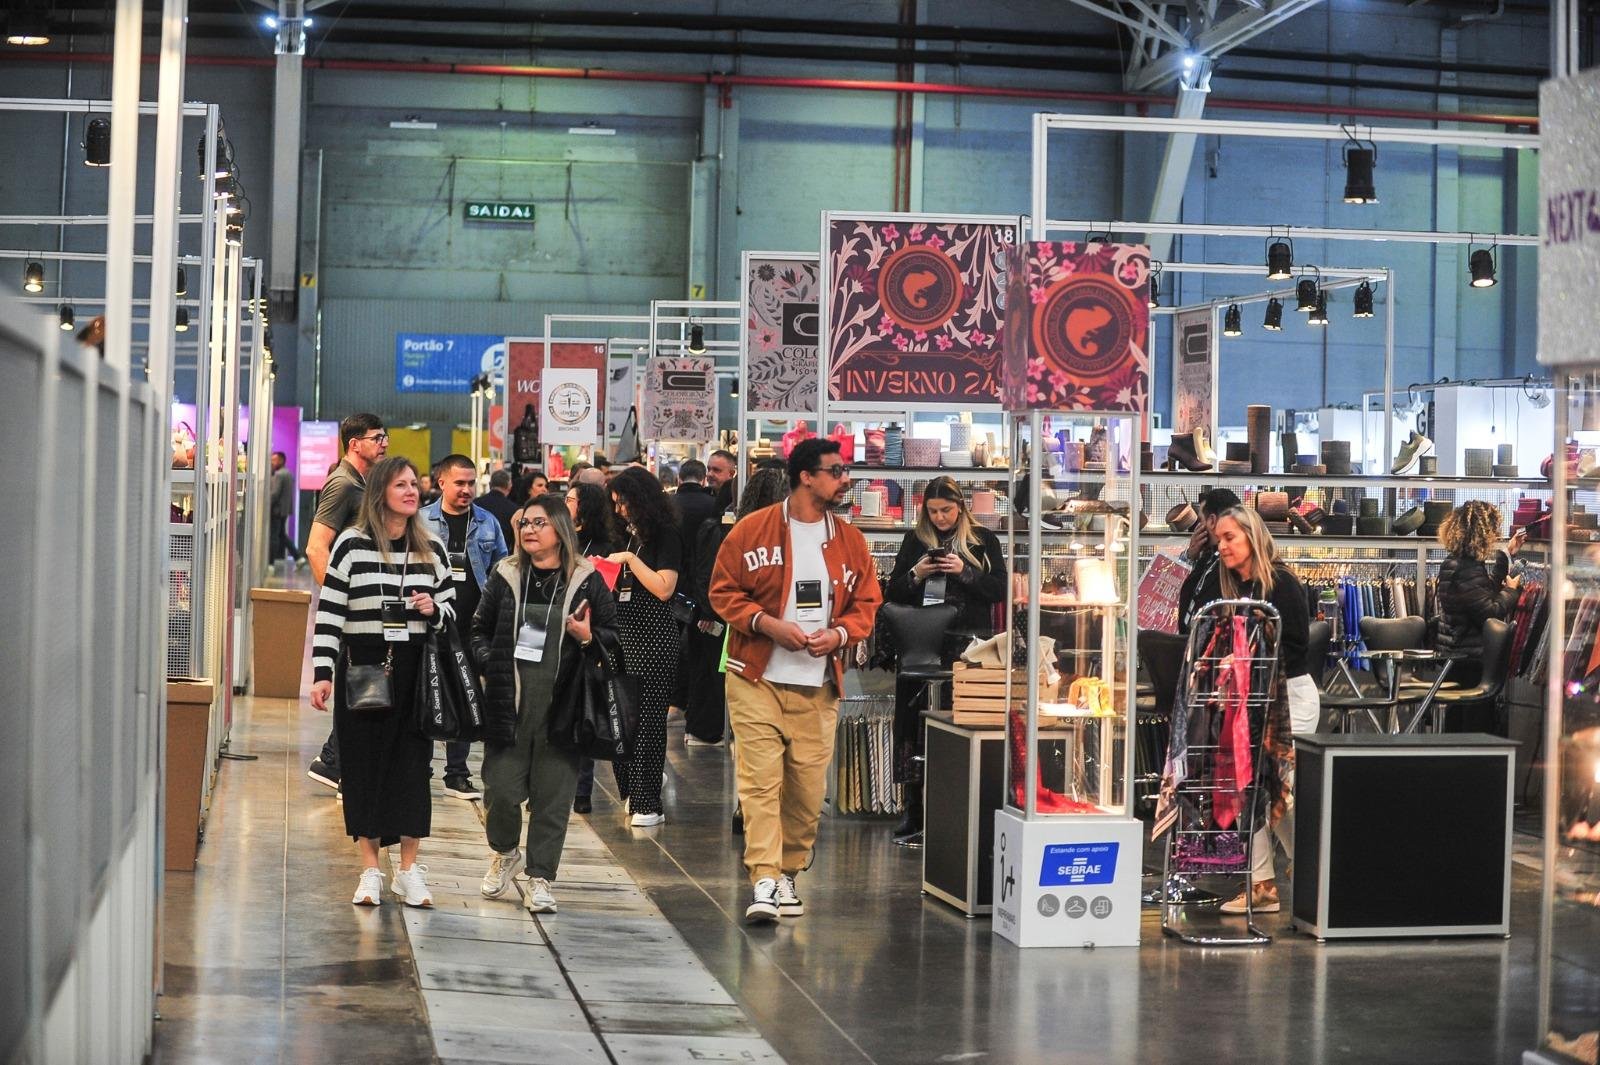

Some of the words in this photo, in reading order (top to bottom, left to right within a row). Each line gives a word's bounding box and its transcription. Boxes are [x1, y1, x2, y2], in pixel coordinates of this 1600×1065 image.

[995, 229, 1013, 243] 18
[304, 274, 313, 286] 7
[694, 285, 703, 297] 7
[404, 339, 444, 351] Portão
[445, 340, 454, 351] 7
[594, 346, 604, 354] 16
[846, 369, 957, 394] INVERNO
[964, 371, 996, 395] 24
[744, 546, 784, 572] DRA
[460, 665, 471, 687] Soares
[1050, 846, 1075, 854] Estande
[1091, 846, 1109, 854] apoio
[1057, 864, 1101, 876] SEBRAE
